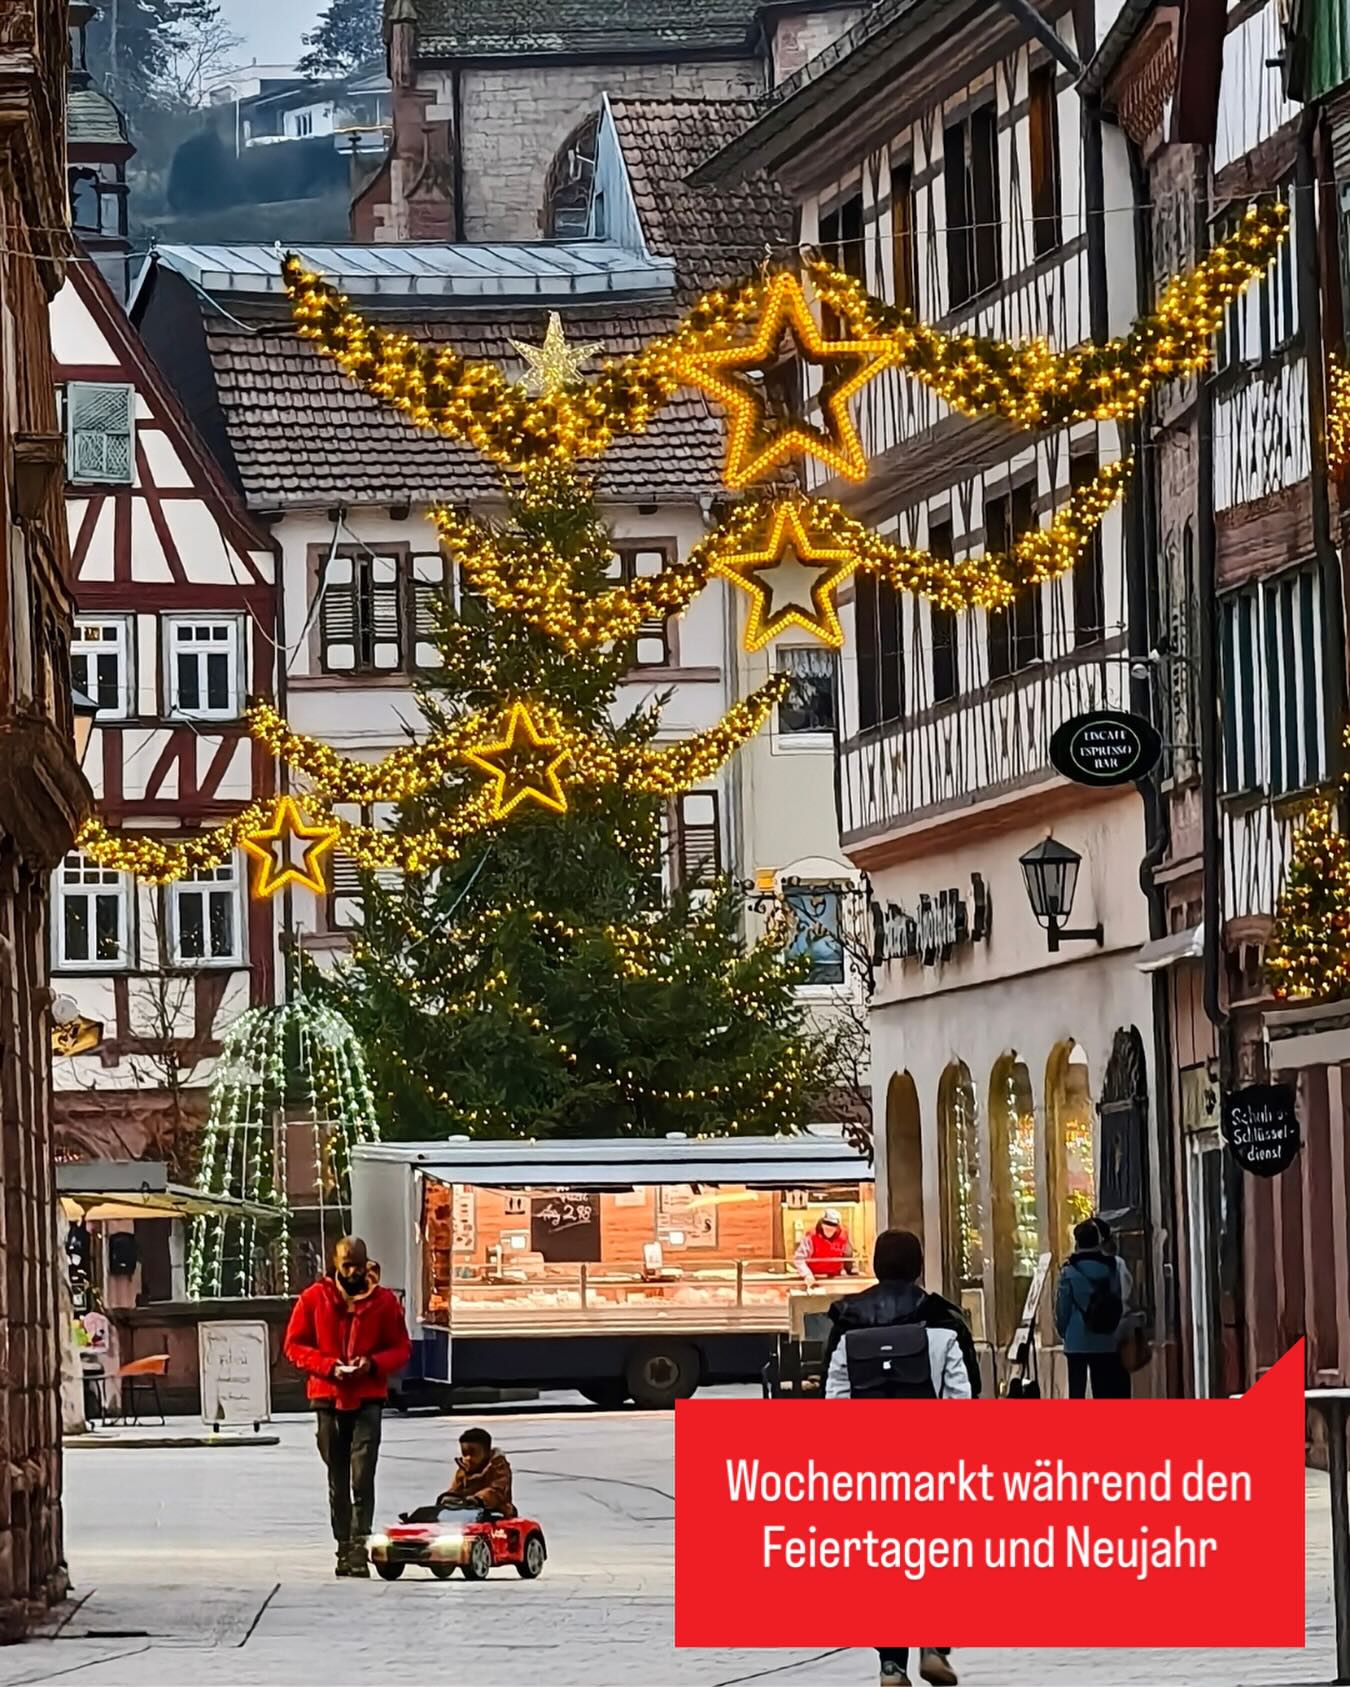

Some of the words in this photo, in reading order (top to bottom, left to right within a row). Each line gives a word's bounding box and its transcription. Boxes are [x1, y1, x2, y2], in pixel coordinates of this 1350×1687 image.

[1080, 746, 1132, 757] ESPRESSO
[1094, 758, 1118, 769] BAR
[1231, 1104, 1273, 1126] Schuh
[1233, 1124, 1295, 1145] Schlüssel-
[1247, 1145, 1282, 1161] dienst
